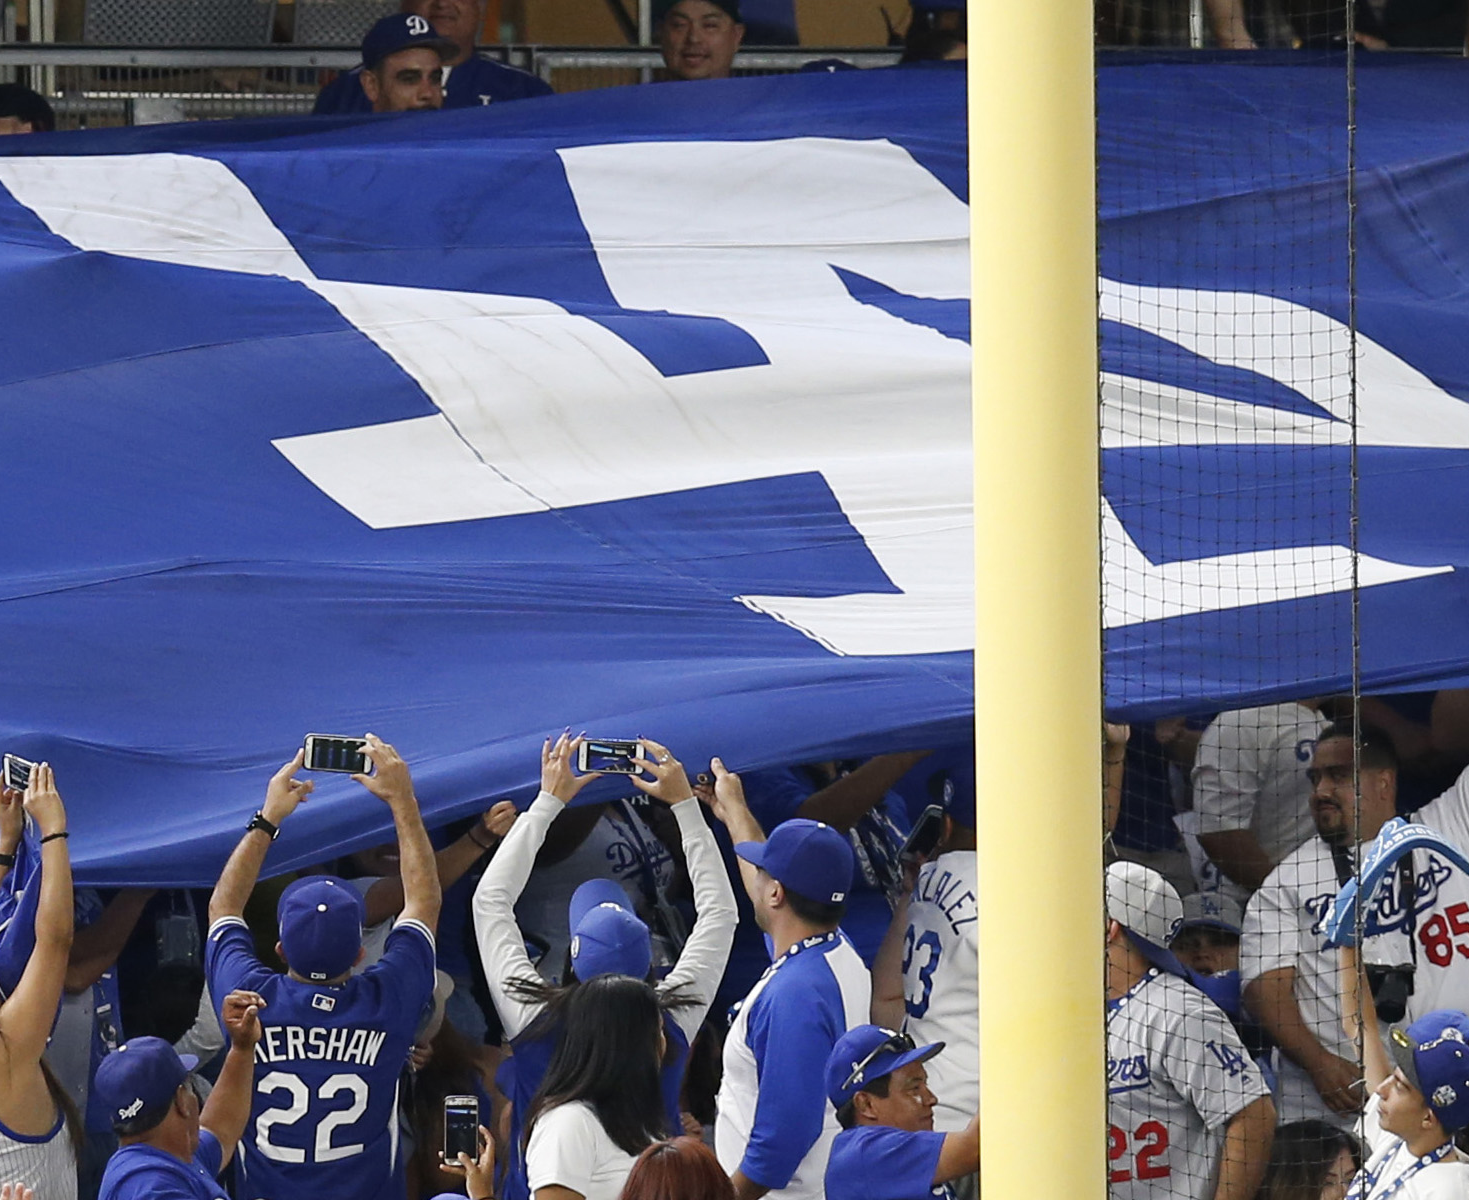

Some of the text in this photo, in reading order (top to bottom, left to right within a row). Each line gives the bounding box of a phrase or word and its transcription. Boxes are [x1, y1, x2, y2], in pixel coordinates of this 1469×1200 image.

[406, 14, 430, 36] D
[1206, 1040, 1248, 1077] LA
[256, 1071, 369, 1164] 22
[1109, 1120, 1172, 1183] 22
